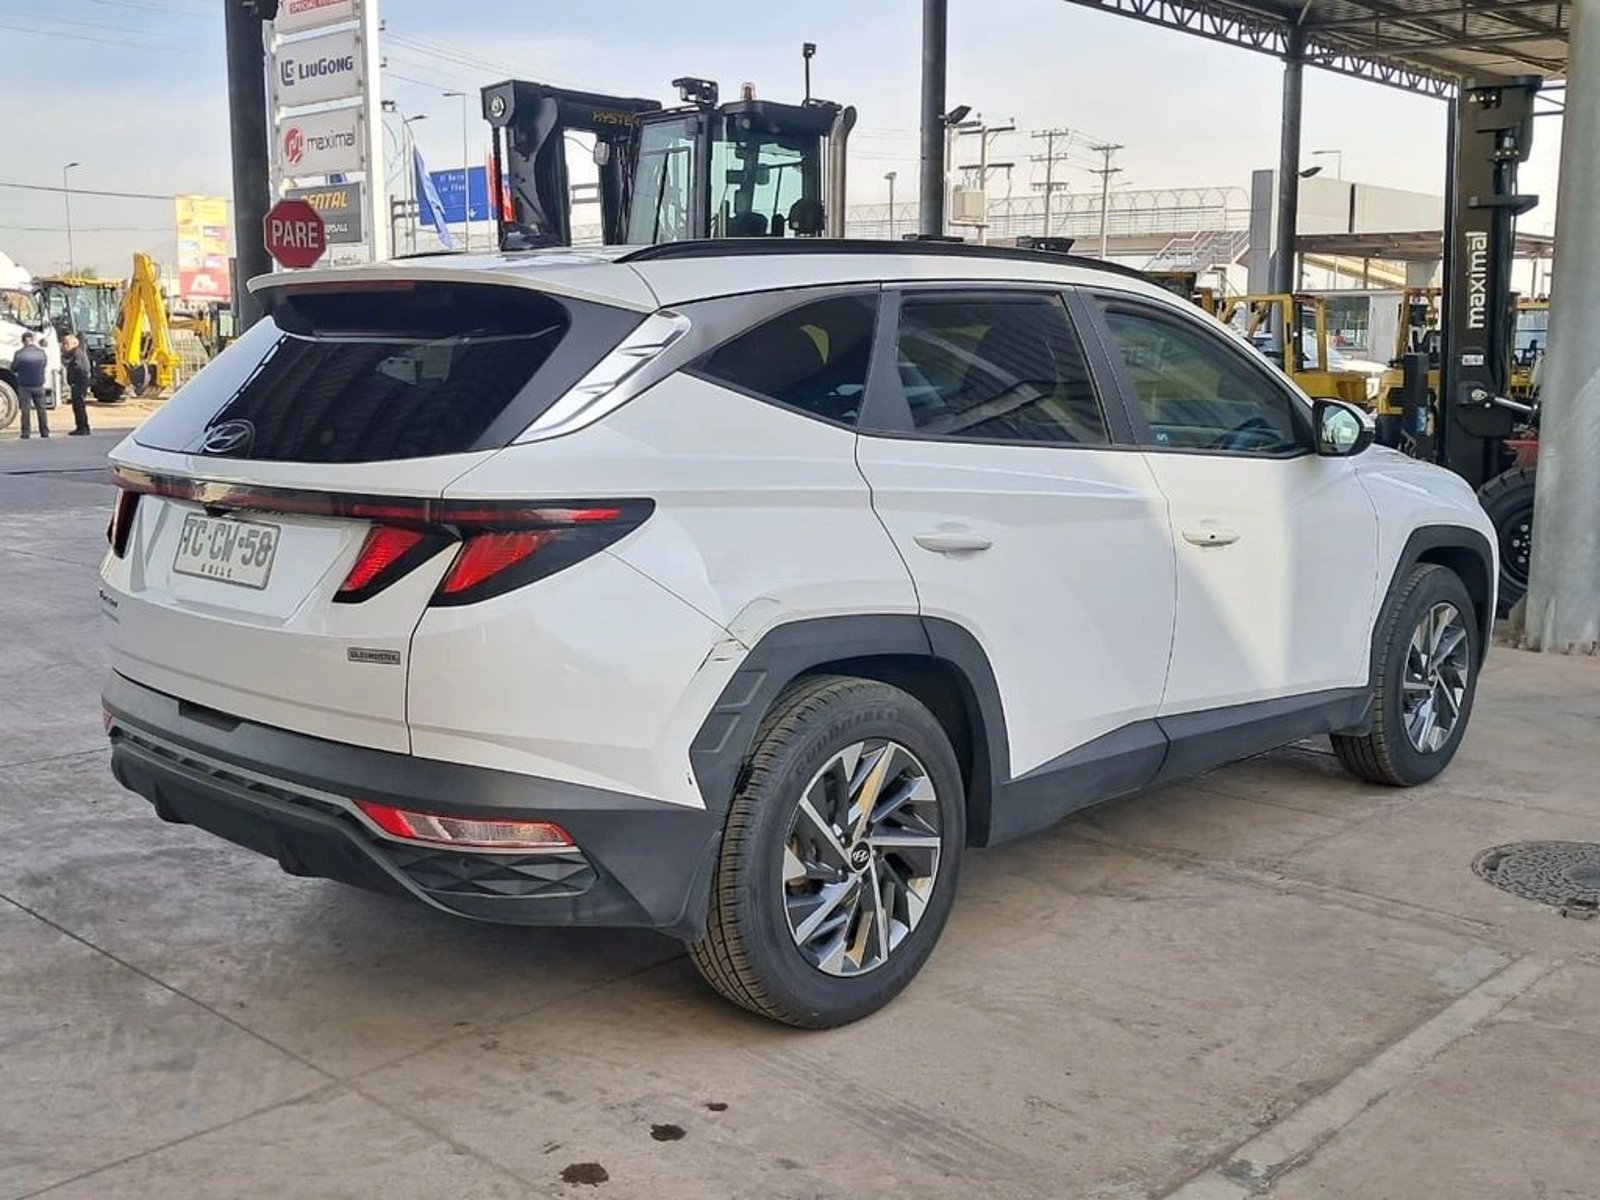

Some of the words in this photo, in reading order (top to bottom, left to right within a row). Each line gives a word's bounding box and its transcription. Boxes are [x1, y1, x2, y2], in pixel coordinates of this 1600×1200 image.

[307, 125, 355, 151] maximal
[301, 190, 348, 210] ENTAL
[272, 220, 319, 249] PARE
[1465, 231, 1488, 329] maximal
